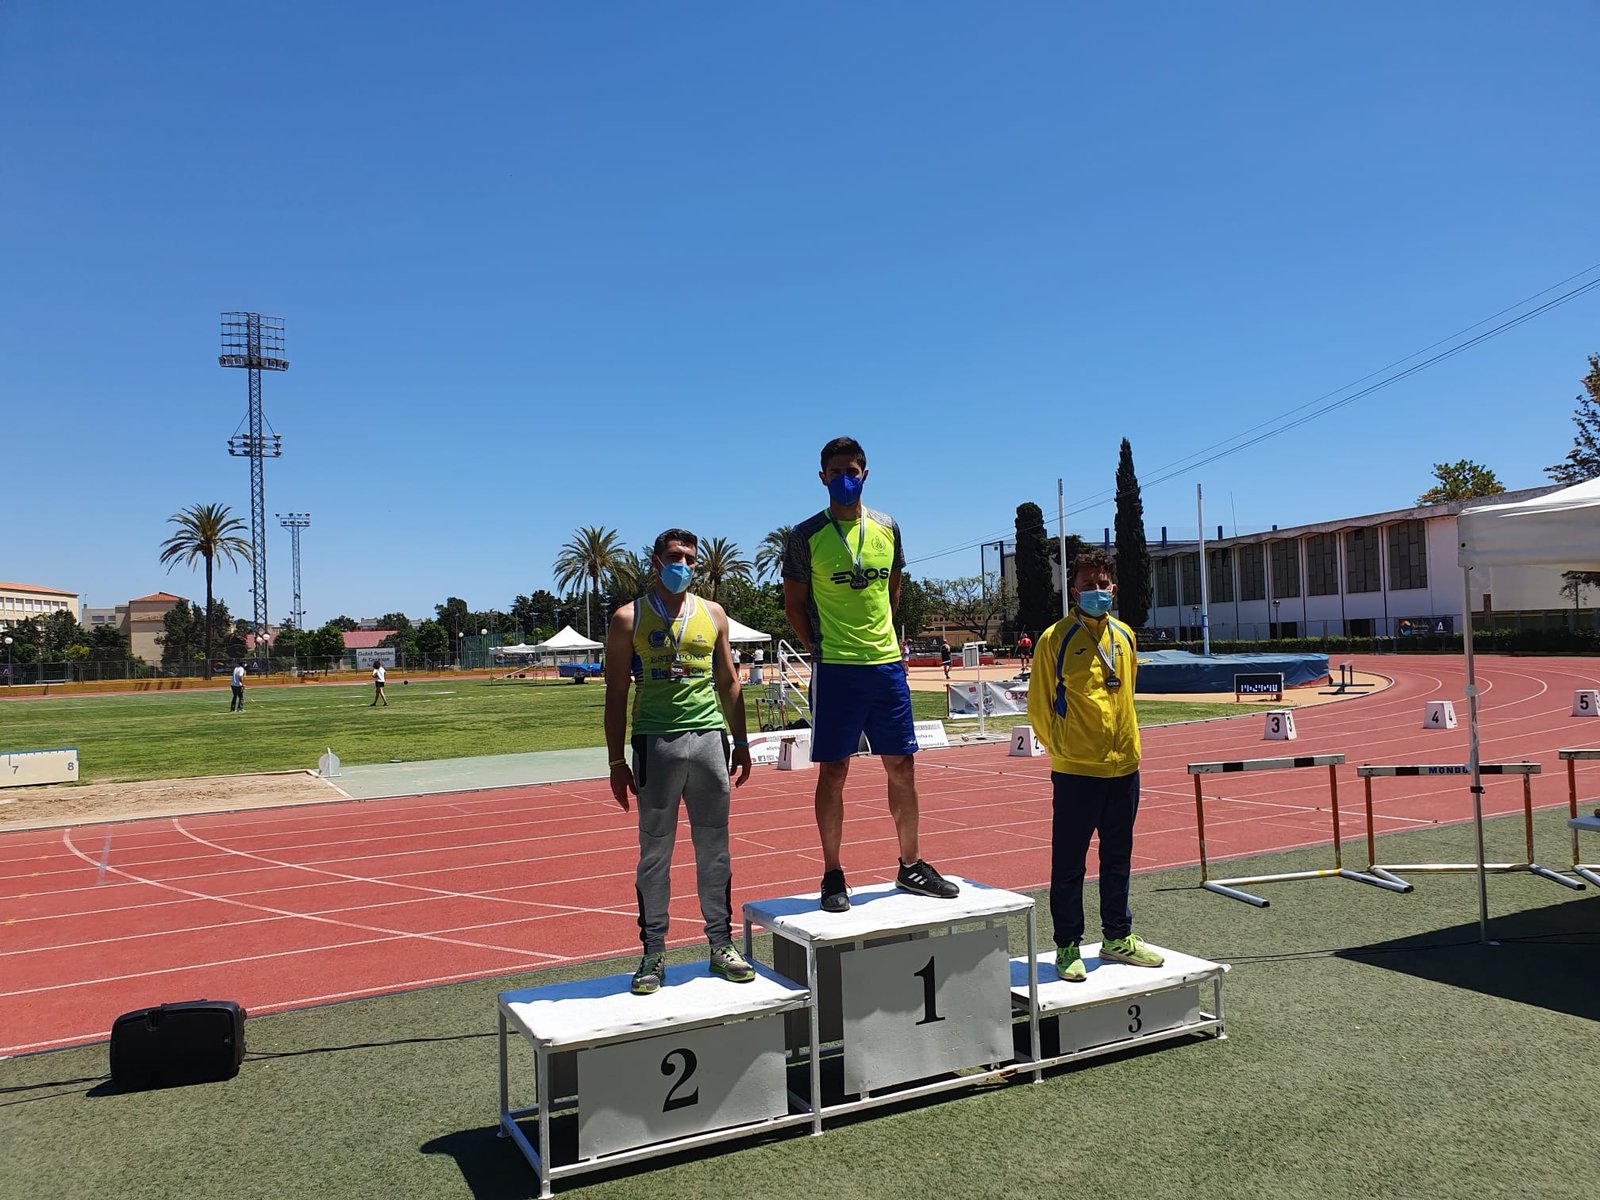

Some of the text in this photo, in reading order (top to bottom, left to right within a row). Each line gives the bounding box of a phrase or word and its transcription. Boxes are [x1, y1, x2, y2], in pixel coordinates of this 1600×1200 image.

[650, 653, 706, 663] ESTPONA
[1580, 695, 1589, 710] 5
[1271, 716, 1280, 733] 3
[1431, 710, 1440, 724] 4
[1017, 735, 1024, 751] 2
[11, 765, 19, 775] 7
[67, 762, 75, 771] 8
[914, 955, 946, 1026] 1
[1127, 1004, 1142, 1034] 3
[660, 1047, 699, 1113] 2
